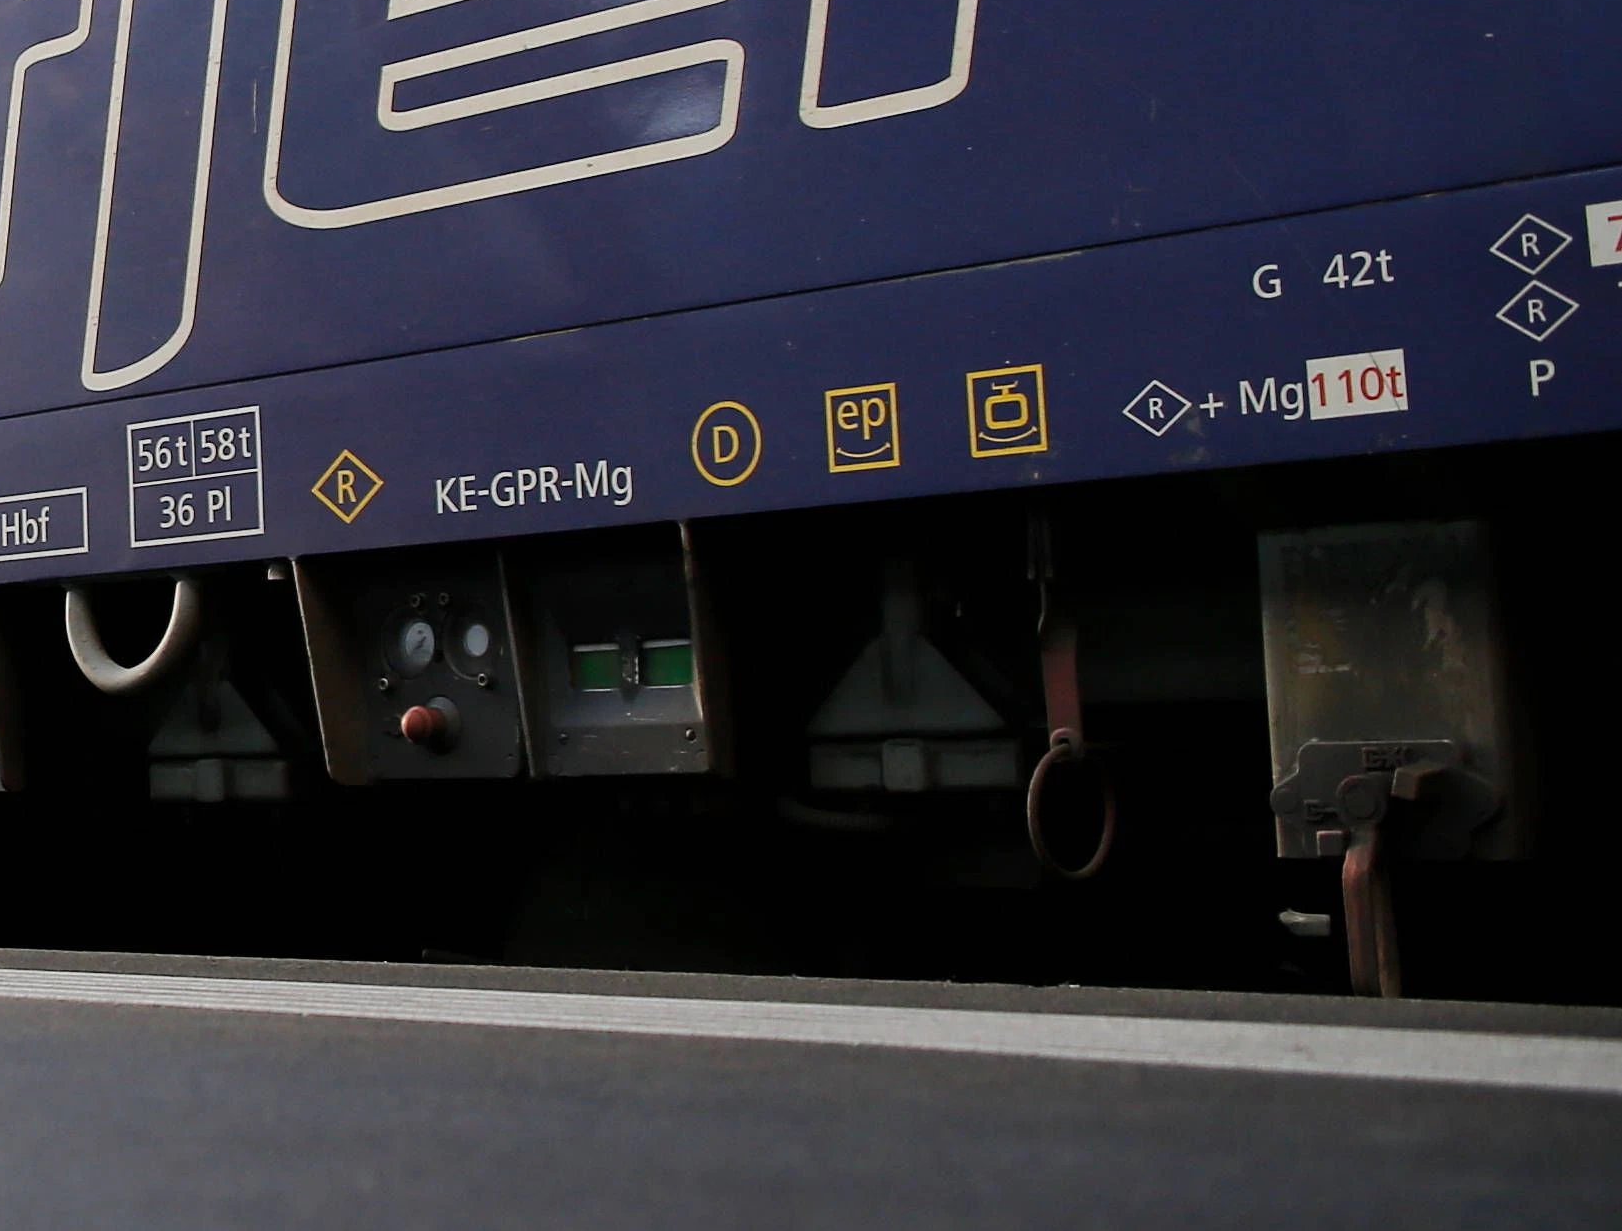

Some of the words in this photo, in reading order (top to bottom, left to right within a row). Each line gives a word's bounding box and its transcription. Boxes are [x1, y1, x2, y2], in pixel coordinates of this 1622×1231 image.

[1521, 232, 1540, 257] R
[1252, 264, 1283, 300] G
[1322, 249, 1395, 289] 42t
[1527, 299, 1547, 323] R
[1148, 398, 1165, 420] R
[1239, 378, 1304, 421] Mg
[1311, 365, 1404, 408] 110t
[1529, 360, 1556, 397] P
[837, 396, 886, 441] ep
[712, 424, 740, 464] D
[159, 493, 195, 529] 36
[207, 485, 232, 524] Pl
[336, 469, 357, 505] R
[435, 460, 633, 514] KE-GPR-Mg
[1, 506, 50, 548] Hbf
